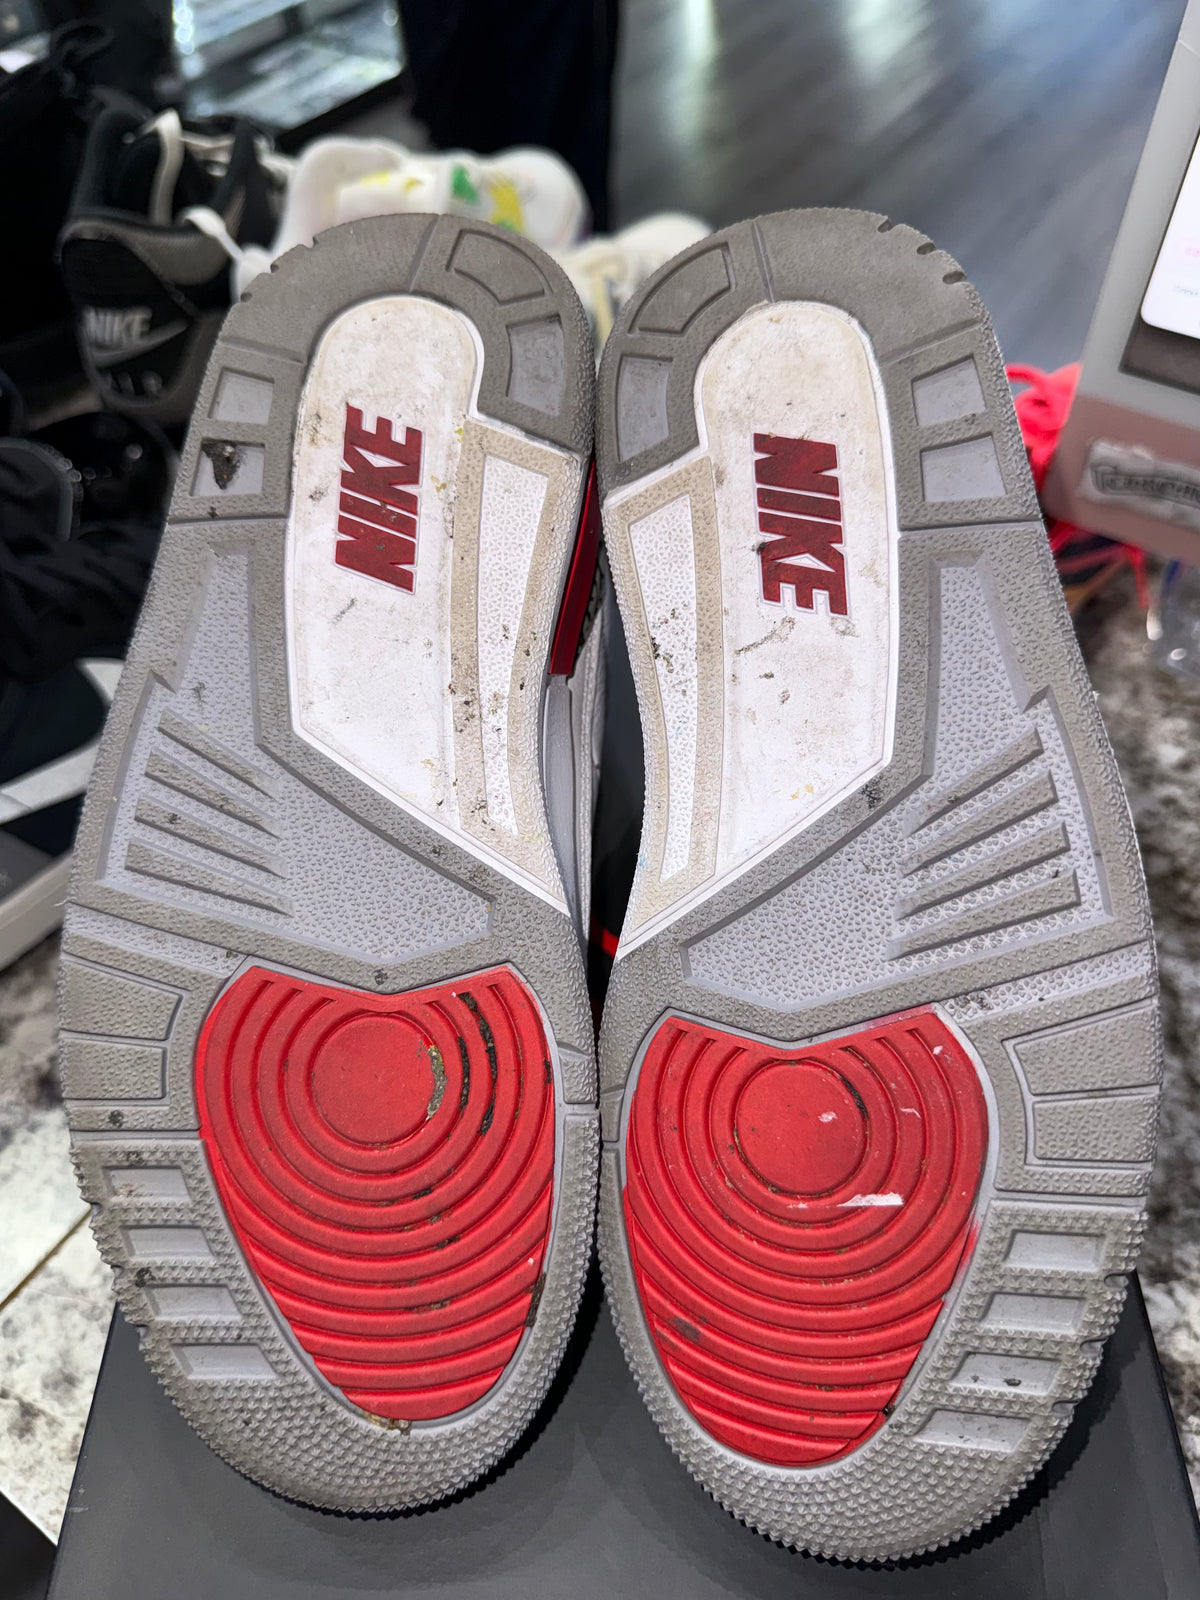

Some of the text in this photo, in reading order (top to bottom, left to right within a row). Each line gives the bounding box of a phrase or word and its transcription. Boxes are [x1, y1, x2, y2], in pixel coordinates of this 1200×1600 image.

[82, 306, 153, 345] NIKE
[335, 403, 423, 593] NIKE
[753, 432, 848, 616] NIKE
